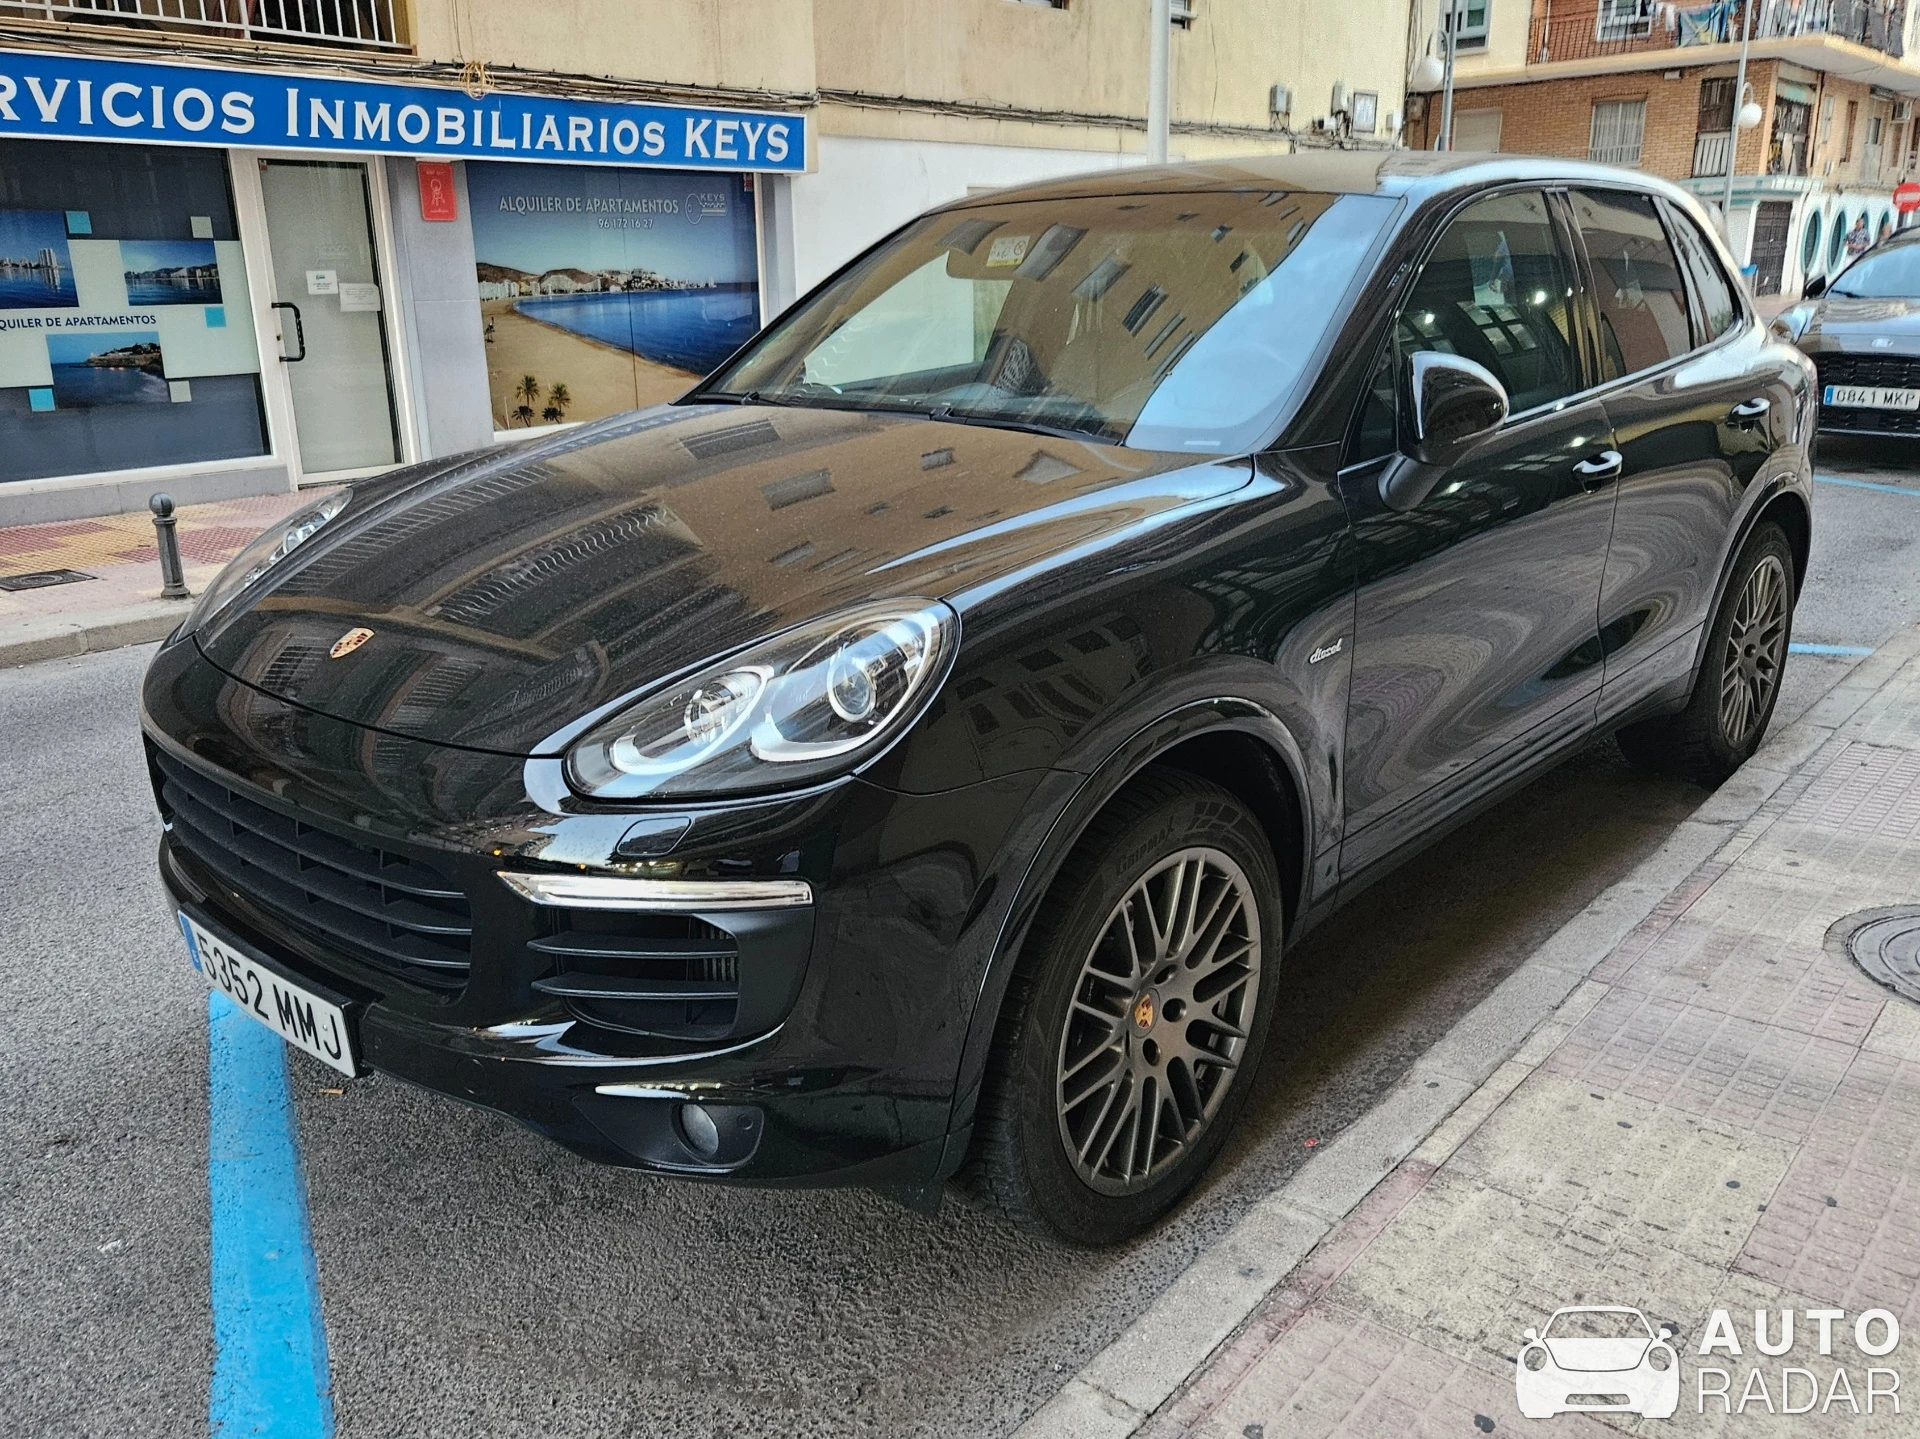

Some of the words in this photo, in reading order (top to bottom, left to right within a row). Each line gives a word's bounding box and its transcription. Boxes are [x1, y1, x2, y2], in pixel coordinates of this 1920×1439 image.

[684, 117, 790, 162] KEYS
[500, 196, 562, 215] ALQUILER
[567, 197, 582, 212] DE
[585, 198, 679, 214] APARTAMENTOS
[700, 193, 725, 201] KEYS
[598, 218, 610, 228] 96
[612, 218, 628, 229] 172
[631, 219, 641, 228] 16
[643, 219, 653, 229] 27
[46, 317, 62, 327] DE
[65, 315, 157, 327] APARTAMENTOS
[1836, 389, 1877, 404] 0841
[1883, 391, 1915, 406] MKP
[196, 932, 270, 1021] 5352
[272, 983, 342, 1060] MMJ
